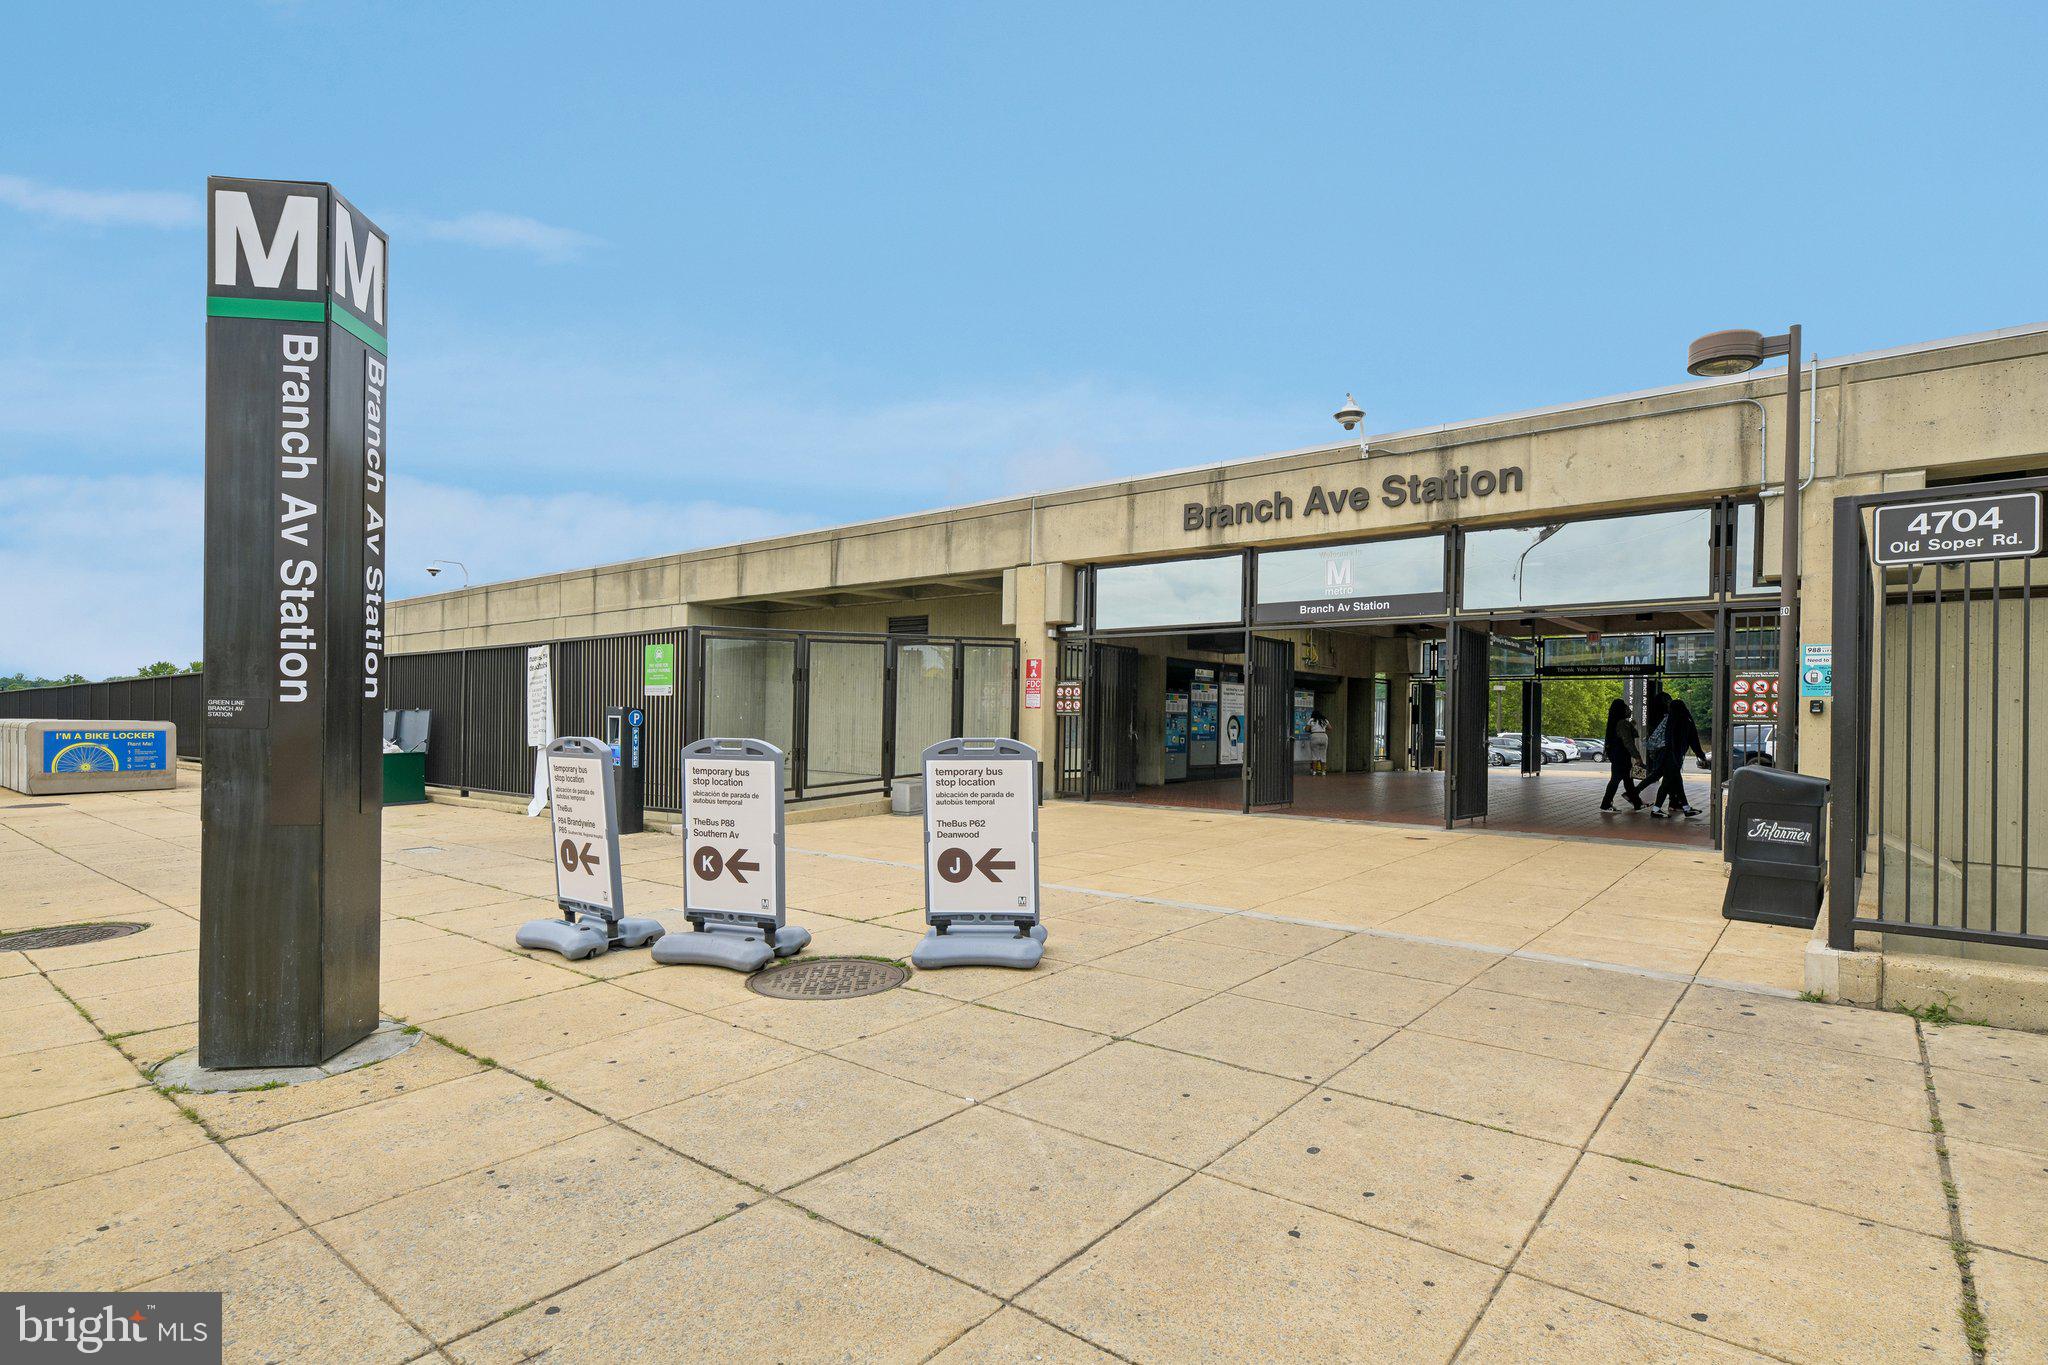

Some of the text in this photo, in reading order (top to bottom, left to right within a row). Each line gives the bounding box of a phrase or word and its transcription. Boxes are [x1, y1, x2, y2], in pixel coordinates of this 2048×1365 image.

[215, 190, 318, 290] M
[335, 200, 384, 326] M
[1183, 465, 1524, 531] Branch Ave Station
[280, 334, 319, 703] Branch Av Station
[1907, 507, 2004, 535] 4704
[364, 356, 385, 698] Branch Av Station
[1890, 532, 2022, 554] Old Soper Rd.
[1327, 560, 1351, 586] M
[1325, 587, 1353, 595] metro
[1300, 600, 1390, 614] Branch Av Station
[1624, 656, 1634, 664] M
[1635, 656, 1648, 664] M
[1026, 680, 1041, 688] FDC
[633, 712, 640, 724] P
[56, 732, 71, 740] I'M
[84, 732, 110, 740] BIKE
[112, 732, 155, 740] LOCKER
[553, 765, 588, 774] temporary bus
[692, 767, 750, 777] temporary bus
[935, 767, 1003, 777] temporary bus
[555, 775, 584, 783] stop location
[692, 777, 743, 787] stop location
[935, 778, 996, 788] stop location
[730, 791, 751, 800] parada
[980, 791, 1004, 800] parada
[557, 803, 573, 813] TheBus
[964, 799, 995, 807] temporal
[567, 817, 596, 828] Brandywine
[693, 818, 735, 827] TheBus P88
[936, 820, 986, 828] TheBus P62
[693, 829, 740, 839] Southern Av
[936, 831, 980, 839] Deanwood
[1747, 821, 1811, 842] Informer
[566, 848, 574, 864] L
[702, 855, 715, 872] K
[949, 857, 961, 874] J
